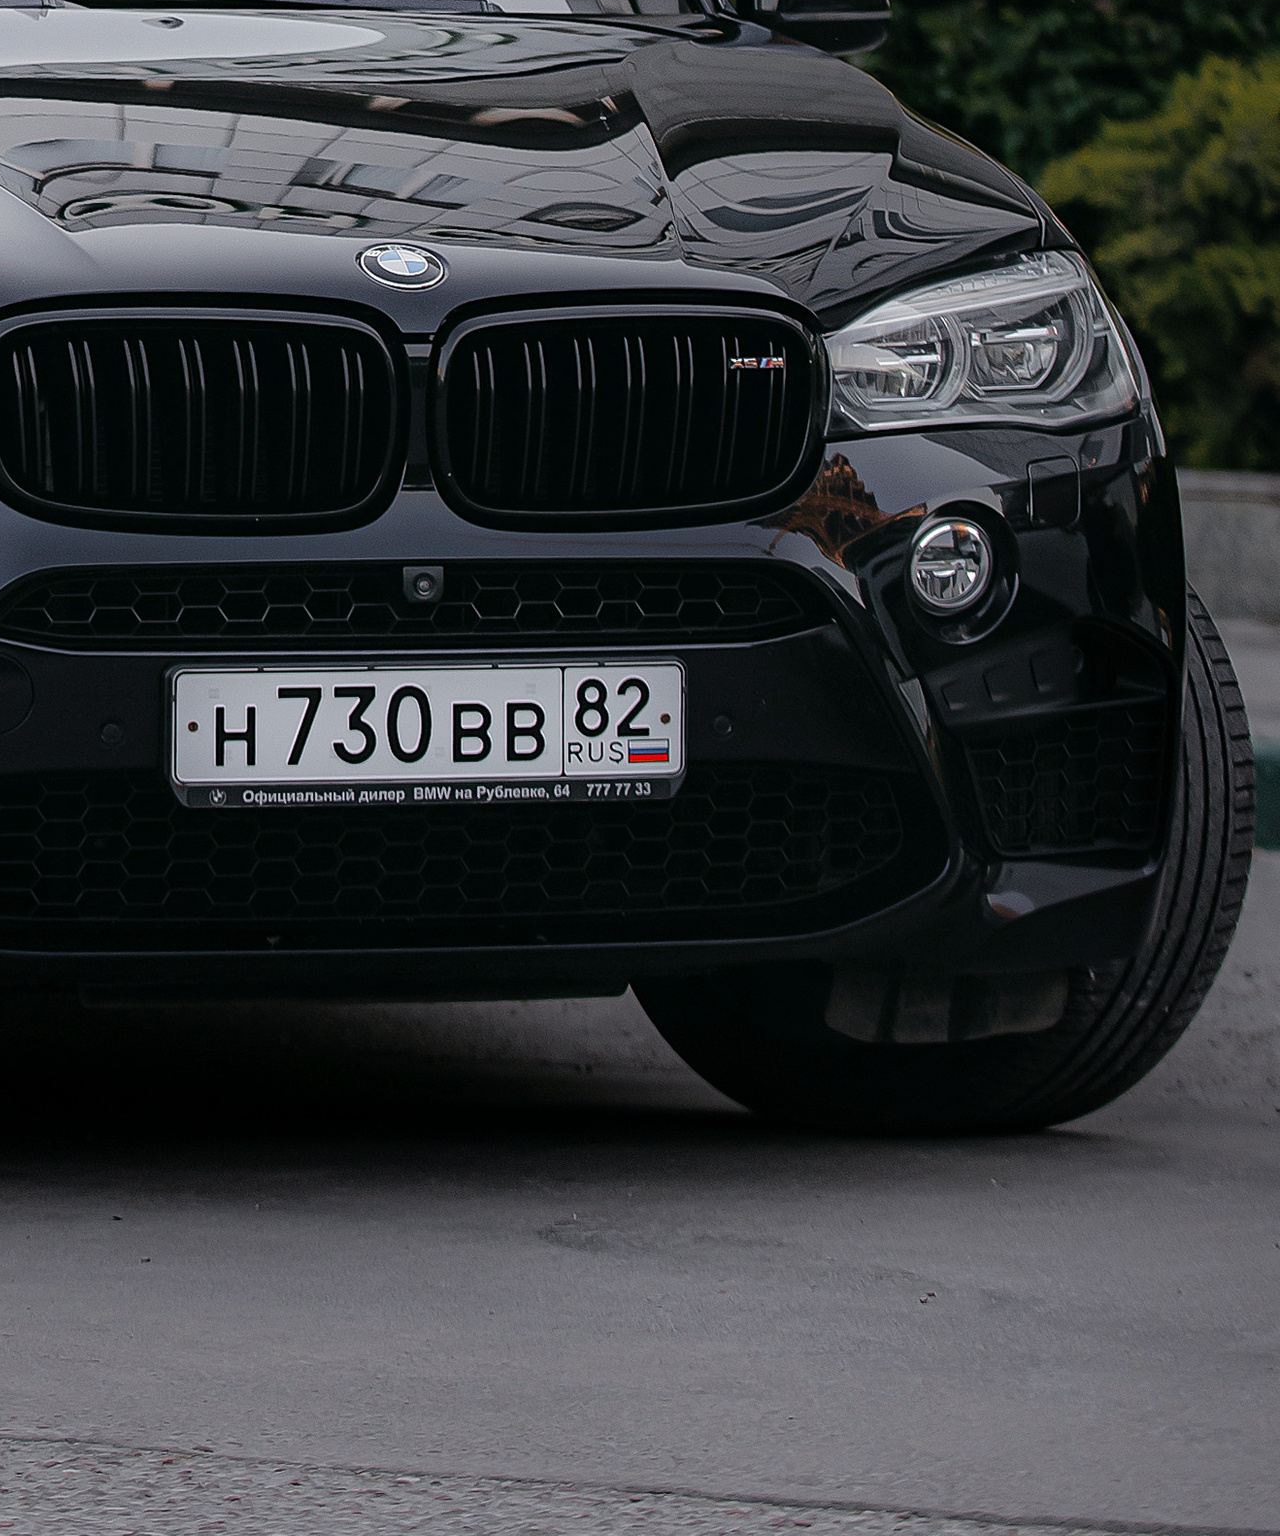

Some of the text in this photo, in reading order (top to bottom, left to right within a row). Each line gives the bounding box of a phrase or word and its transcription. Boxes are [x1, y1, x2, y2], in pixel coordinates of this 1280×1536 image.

[573, 677, 651, 737] 82
[567, 741, 625, 765] RUS
[242, 789, 355, 805] Официальный
[413, 786, 452, 800] BMW
[455, 788, 473, 800] на
[586, 782, 610, 797] 777
[614, 782, 631, 796] 77
